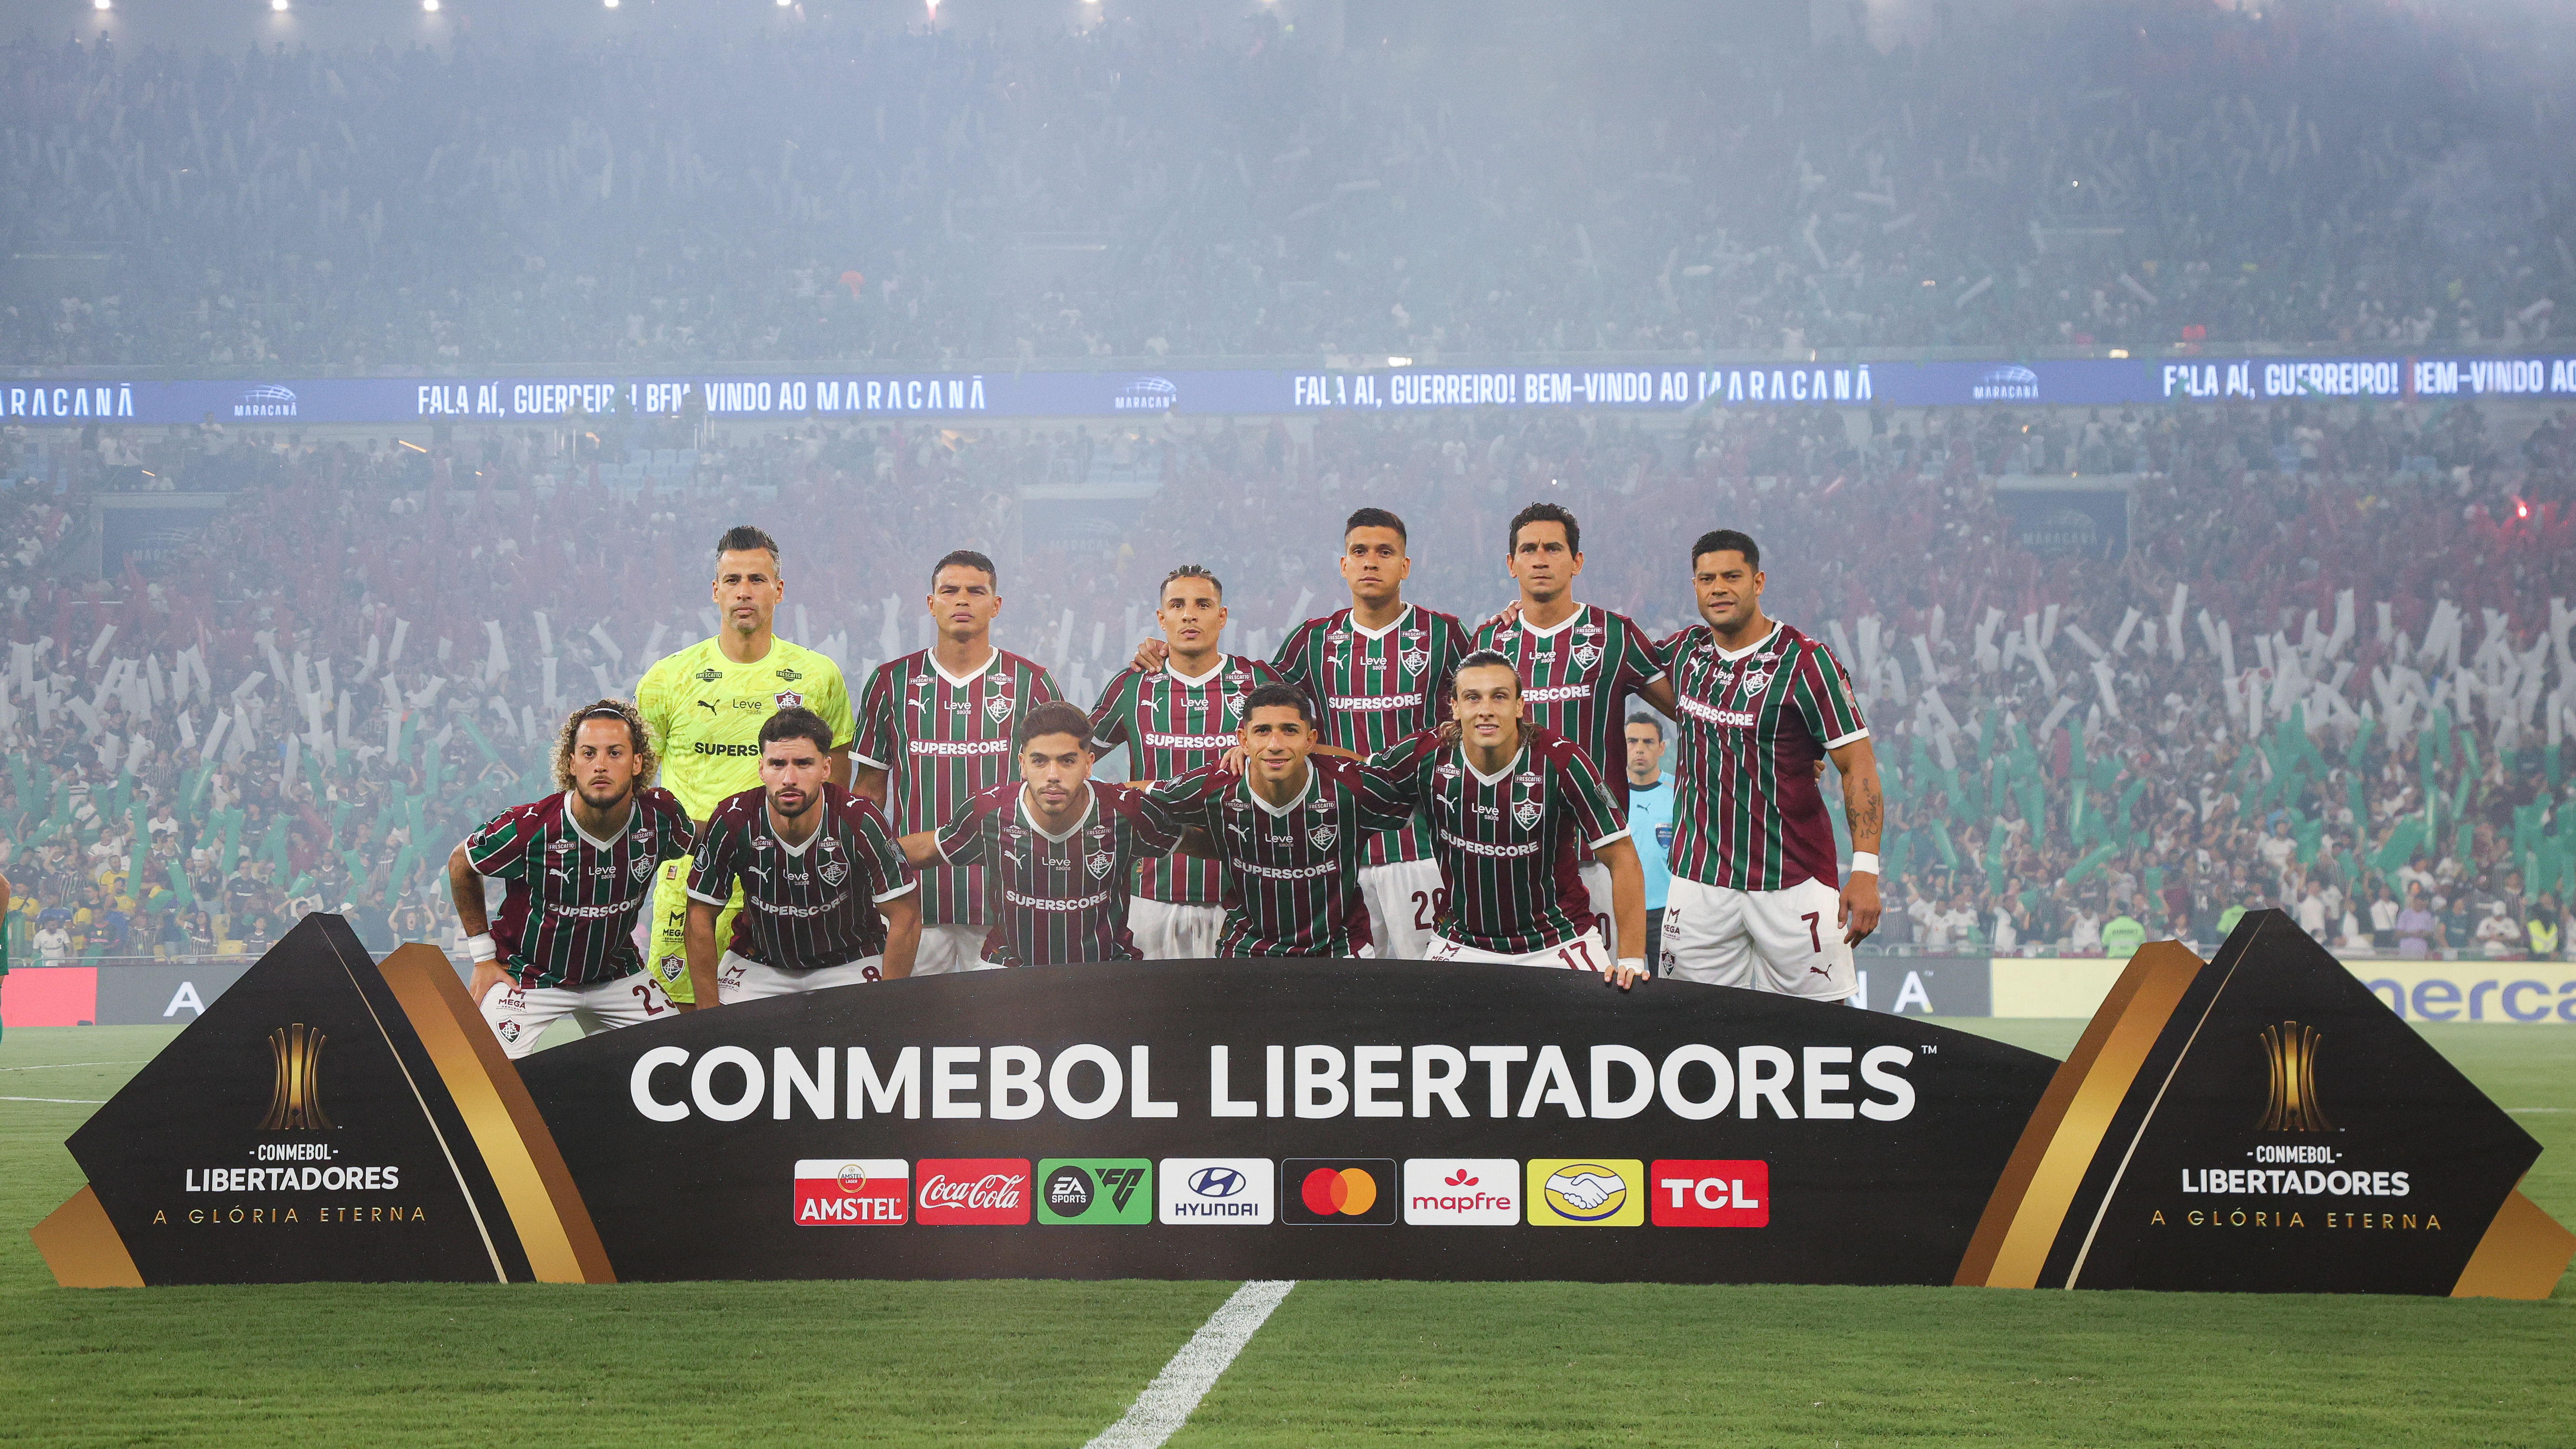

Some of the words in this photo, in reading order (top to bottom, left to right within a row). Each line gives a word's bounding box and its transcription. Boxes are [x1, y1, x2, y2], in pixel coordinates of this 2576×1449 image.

[2265, 362, 2399, 396] GUERREIRO!
[418, 385, 469, 414] FALA
[514, 383, 638, 414] GUERREIR!
[778, 381, 807, 411] AO
[816, 375, 986, 410] MARACANÃ
[1294, 375, 1347, 406] FALA
[1391, 373, 1516, 404] GUERREIRO!
[1524, 371, 1652, 403] BEM-VINDO
[1660, 371, 1689, 403] AO
[1360, 656, 1387, 666] Leve
[1529, 651, 1557, 659] Leve
[777, 671, 802, 679] FRESCATTO
[988, 675, 1012, 683] FRESCATTO
[1521, 684, 1591, 702] ERSCORE
[733, 698, 762, 709] Leve
[944, 701, 972, 710] Leve
[1181, 698, 1209, 707] Leve
[1329, 693, 1422, 709] SUPERSCORE
[1680, 695, 1754, 727] SUPERSCORE
[909, 740, 1008, 755] SUPERSCORE
[1145, 734, 1240, 748] SUPERSCOR
[694, 742, 759, 757] SUPERS
[1437, 767, 1460, 776] FRESCATTO
[1471, 802, 1499, 815] Leve
[632, 831, 654, 840] FRESCATTO
[1003, 827, 1028, 836] FRESCATTO
[1265, 833, 1293, 843] Leve
[1440, 829, 1538, 857] SUPERSCORE
[1042, 856, 1071, 867] Leve
[1233, 858, 1337, 878] SUPERSCORE
[589, 866, 616, 876] Leve
[783, 869, 809, 881] Leve
[750, 892, 848, 918] SUPERSCORE
[1006, 890, 1108, 911] SUPERSCORE
[1801, 911, 1822, 953] 7
[1558, 941, 1598, 971] 17
[718, 977, 740, 988] MEGA
[499, 999, 526, 1009] MEGA
[630, 1045, 1178, 1122] CONMEBOL
[186, 1166, 399, 1192] LIBERTADORES
[1052, 1177, 1085, 1195] EA
[2182, 1169, 2410, 1196] LIBERTADORES
[919, 1174, 1026, 1209] Coca-Cola
[1661, 1179, 1759, 1209] TCL
[1052, 1195, 1087, 1204] SPORTS
[1413, 1191, 1511, 1214] mapfre
[153, 1210, 167, 1225] A
[189, 1205, 298, 1224] GLÓRIA
[320, 1207, 425, 1222] ETERNA
[1175, 1203, 1258, 1216] HYUNDAI
[2151, 1210, 2166, 1226] A
[2188, 1207, 2305, 1228] GLÓRIA
[2327, 1213, 2442, 1231] ETERNA
